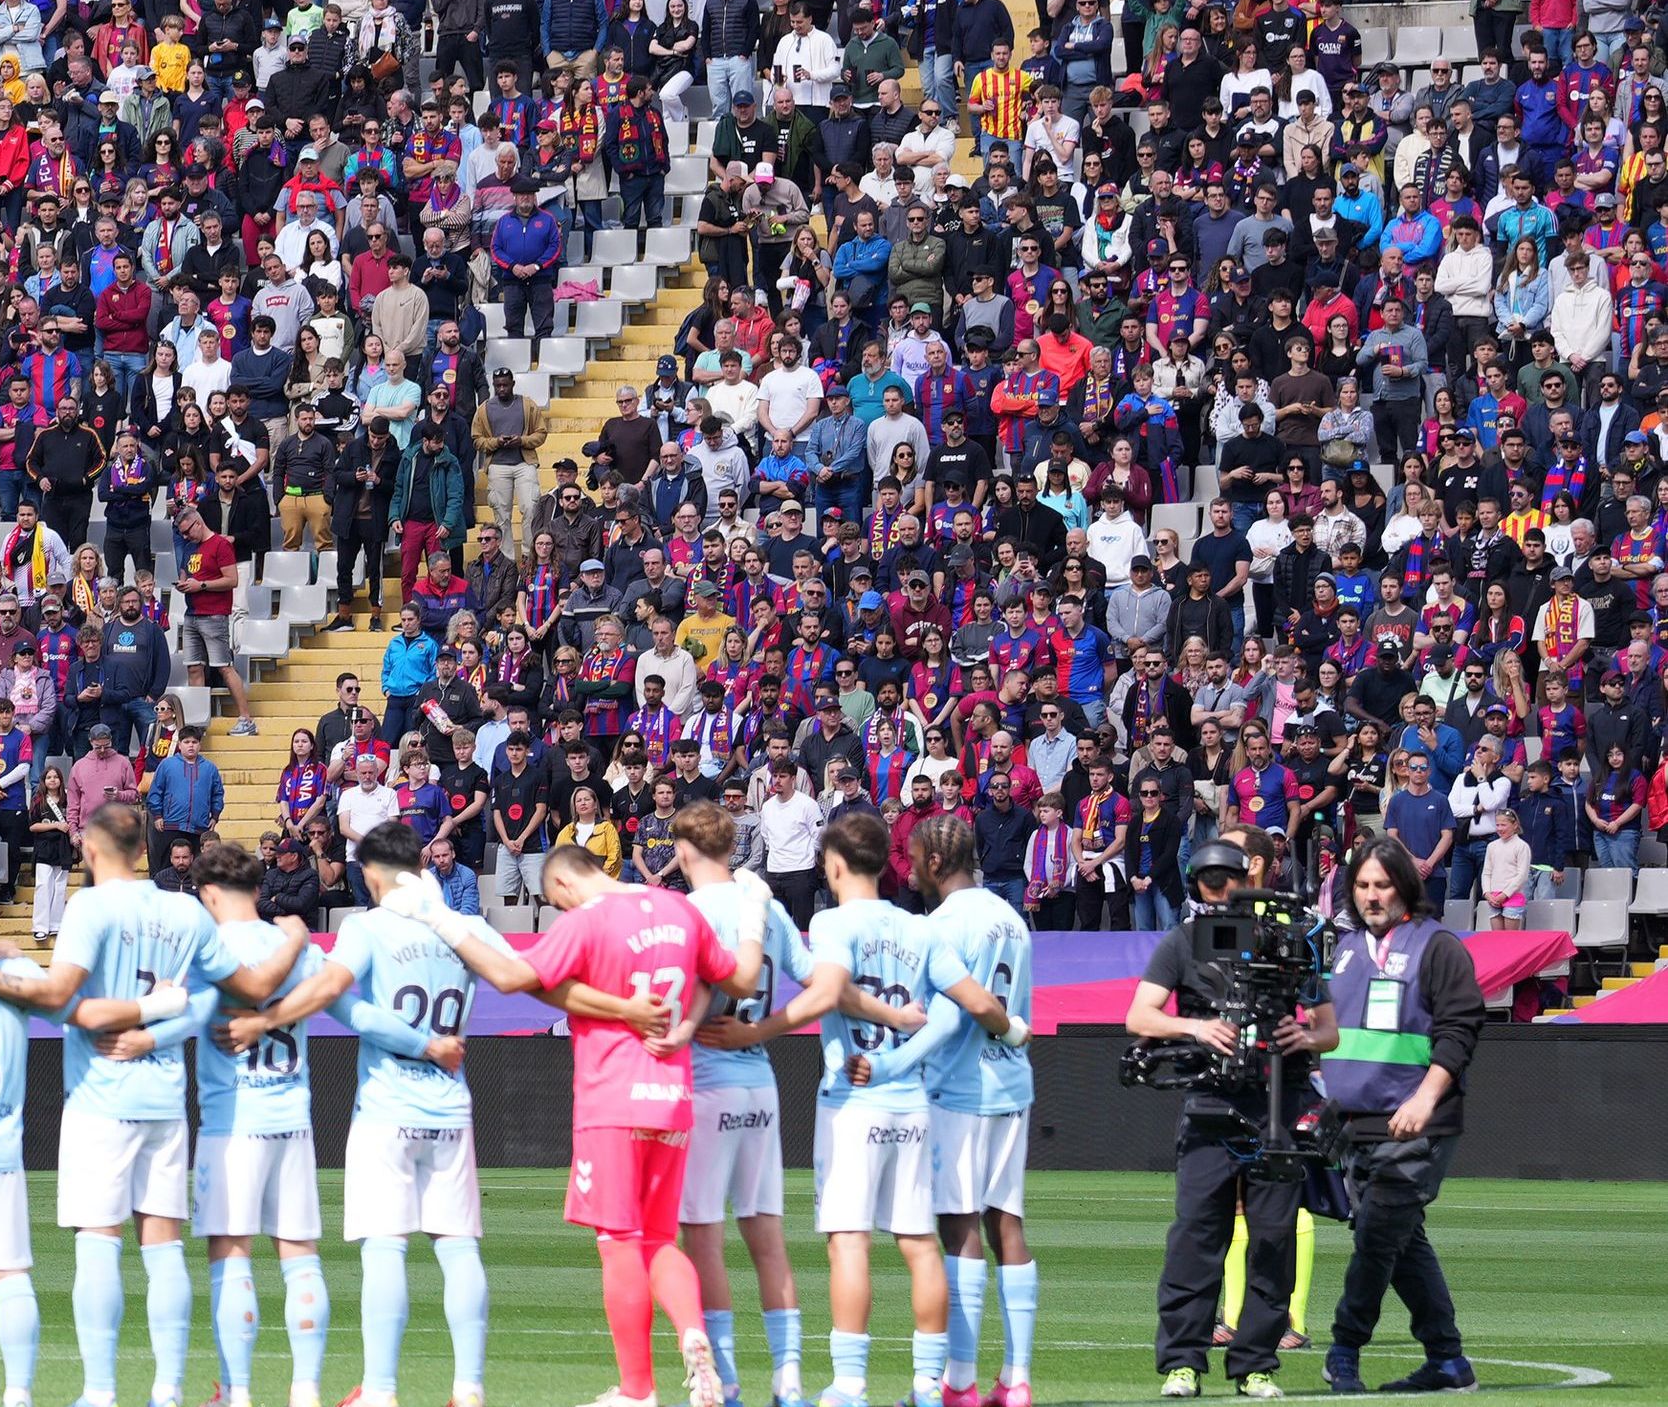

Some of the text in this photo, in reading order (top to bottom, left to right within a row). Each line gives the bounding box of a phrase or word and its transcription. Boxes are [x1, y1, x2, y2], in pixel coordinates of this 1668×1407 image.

[1318, 42, 1342, 50] QATAR
[113, 644, 136, 653] Element
[49, 653, 68, 662] Spotify
[630, 966, 687, 1026] 13
[392, 984, 466, 1038] 29
